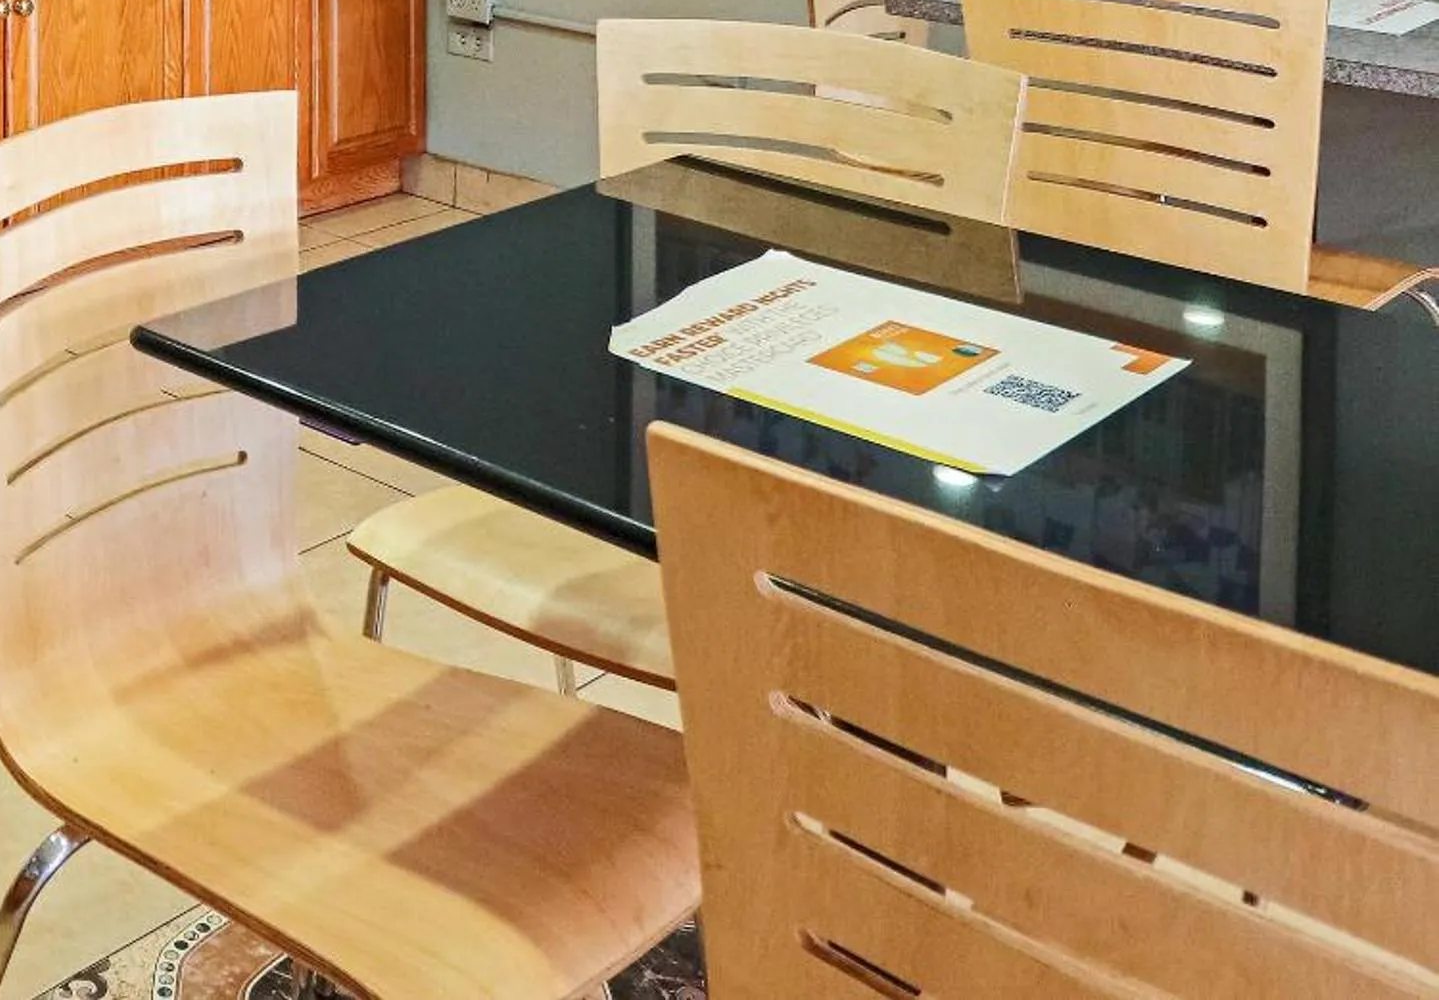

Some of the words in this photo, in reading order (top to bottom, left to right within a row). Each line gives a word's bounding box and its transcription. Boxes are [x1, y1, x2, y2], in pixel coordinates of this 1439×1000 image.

[629, 333, 685, 358] EARN
[681, 302, 759, 337] REWARD
[655, 334, 727, 366] FASTER
